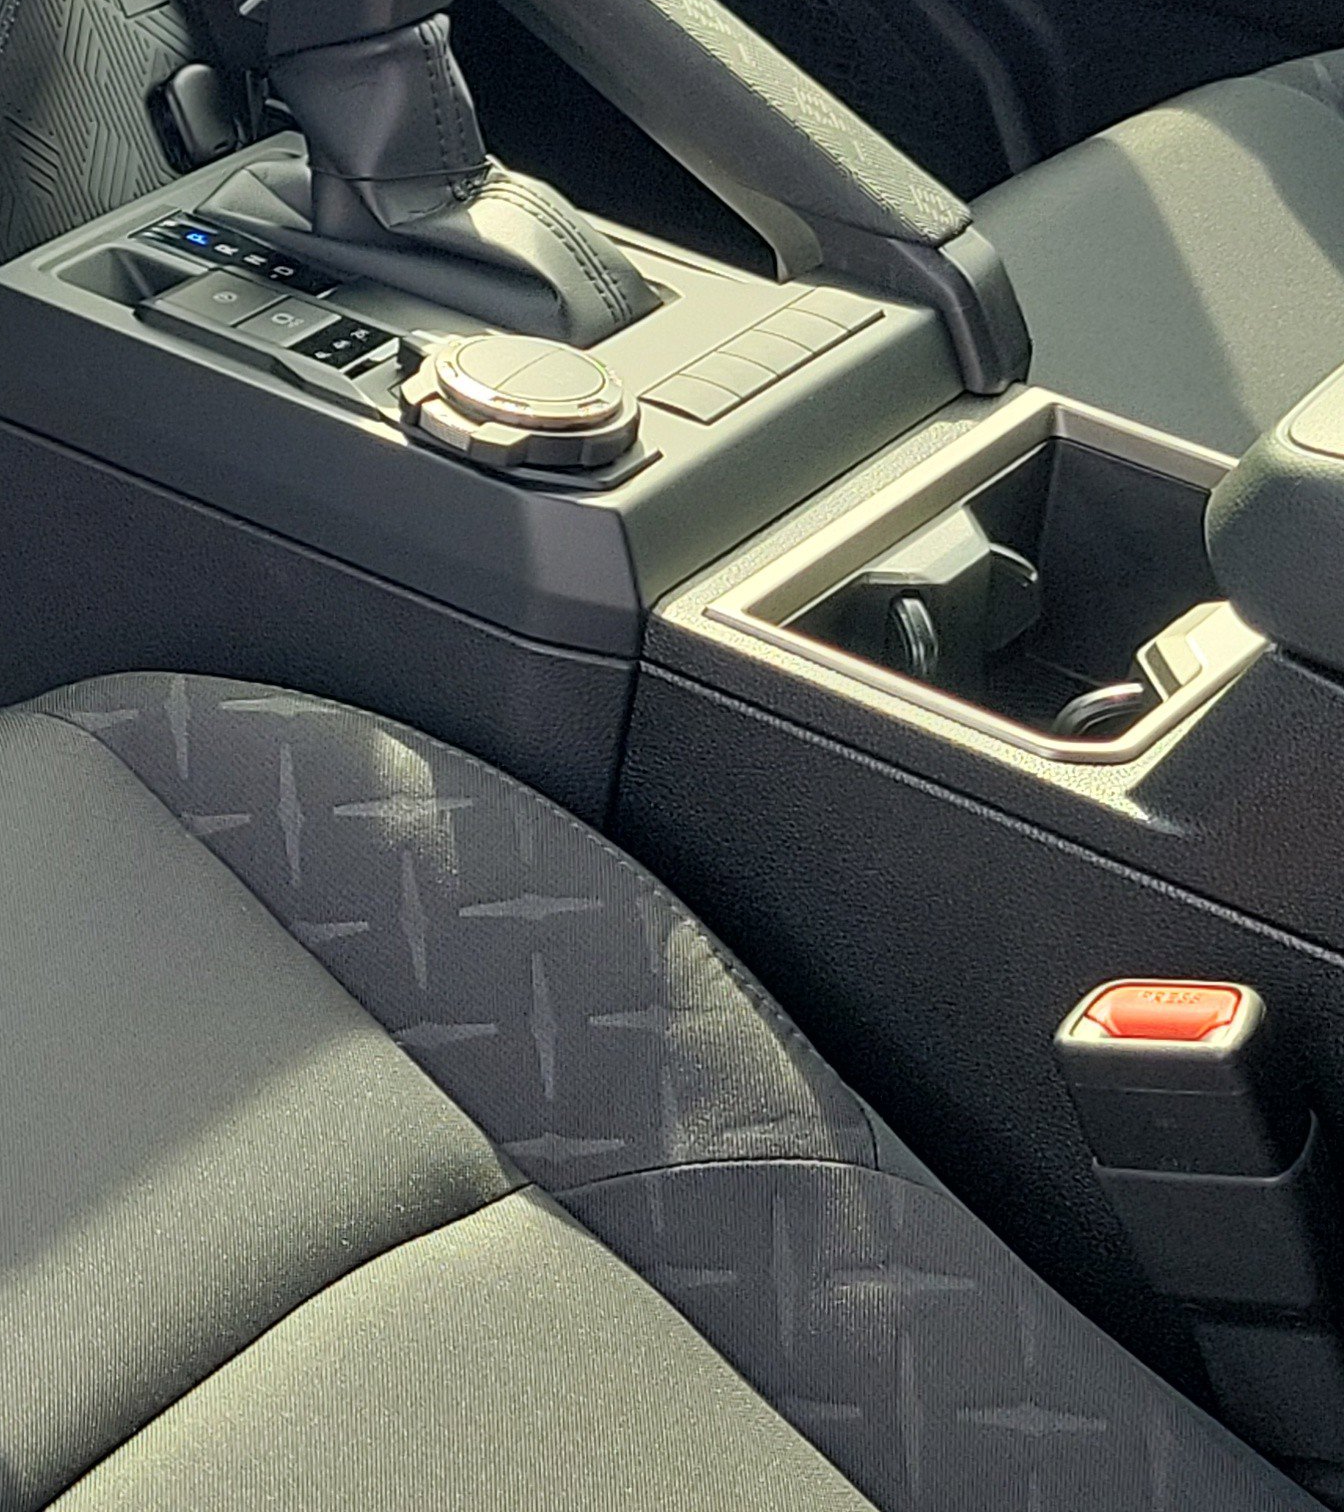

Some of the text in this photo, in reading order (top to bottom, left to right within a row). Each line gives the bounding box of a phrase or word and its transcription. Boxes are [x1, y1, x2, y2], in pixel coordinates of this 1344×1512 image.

[186, 233, 209, 246] P
[214, 243, 239, 256] R
[1140, 990, 1201, 1004] PRESS
